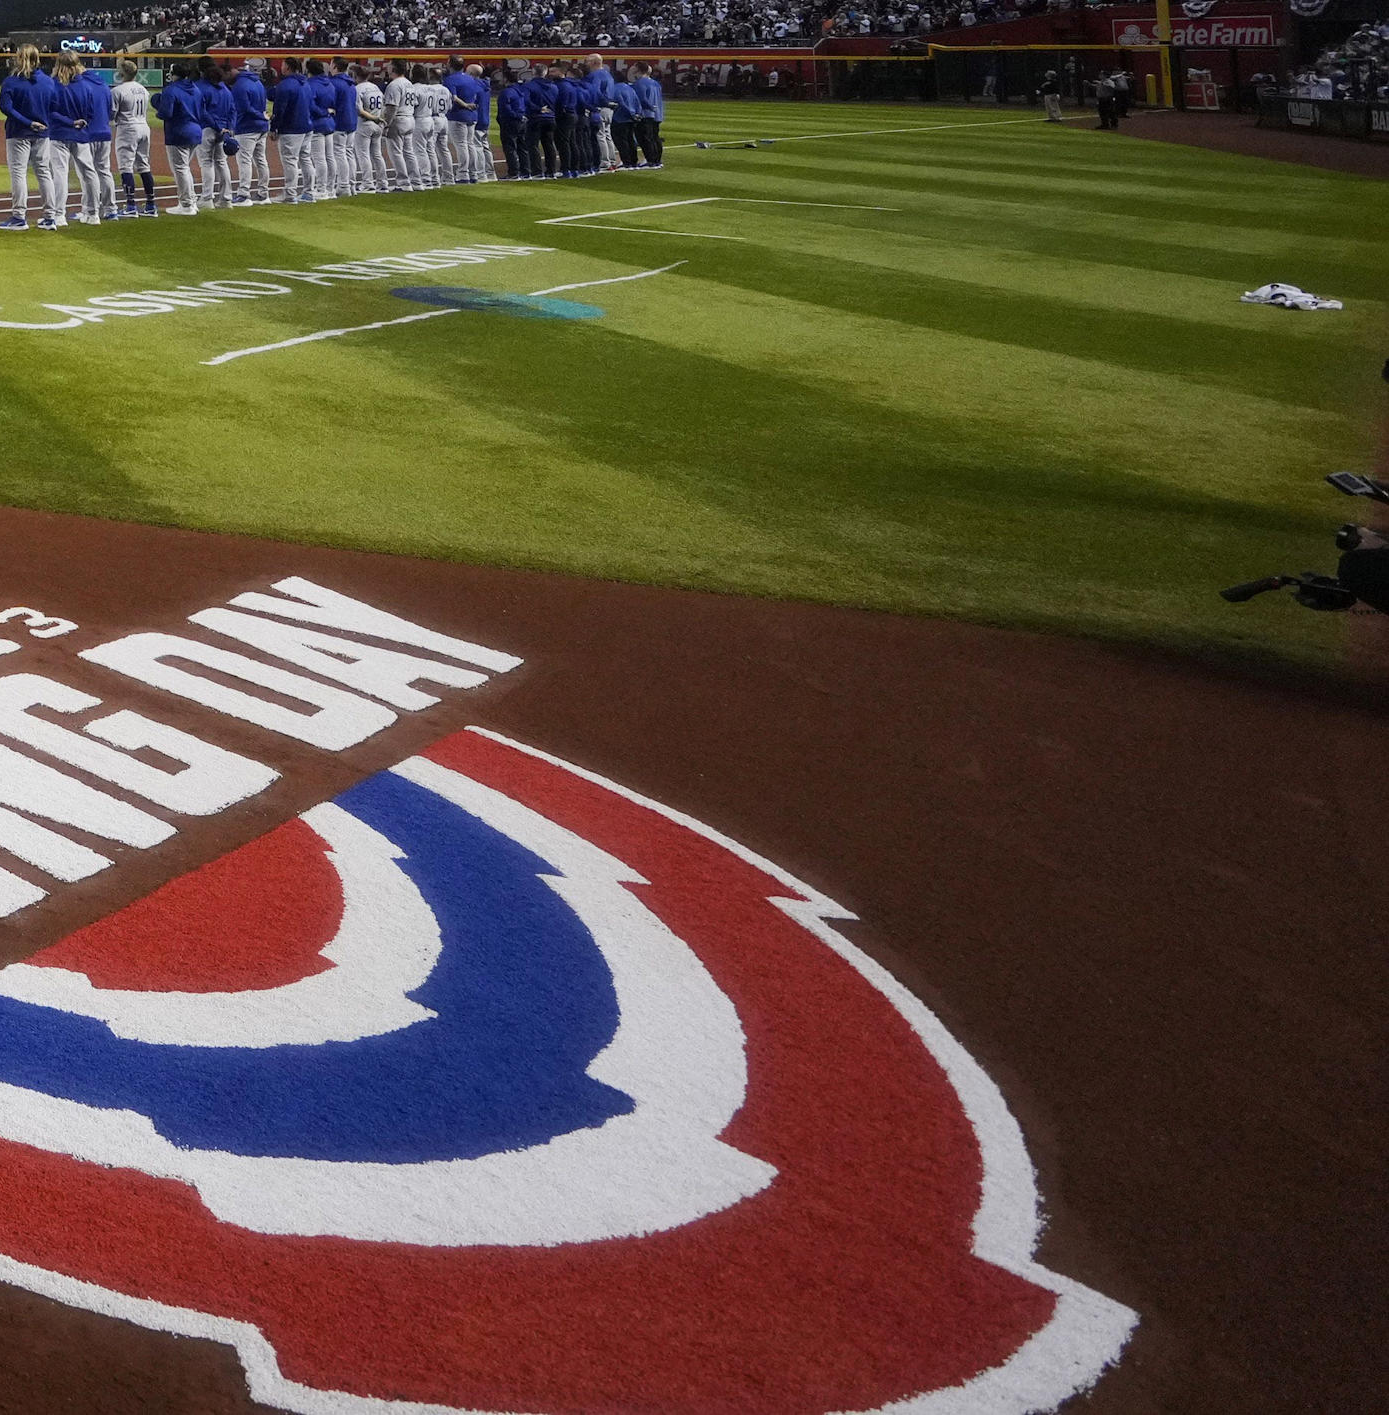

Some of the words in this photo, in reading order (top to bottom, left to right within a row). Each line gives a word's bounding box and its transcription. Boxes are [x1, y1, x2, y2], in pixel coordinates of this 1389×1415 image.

[136, 99, 144, 116] 11
[248, 242, 555, 287] ARIZONA
[78, 574, 526, 752] DAY
